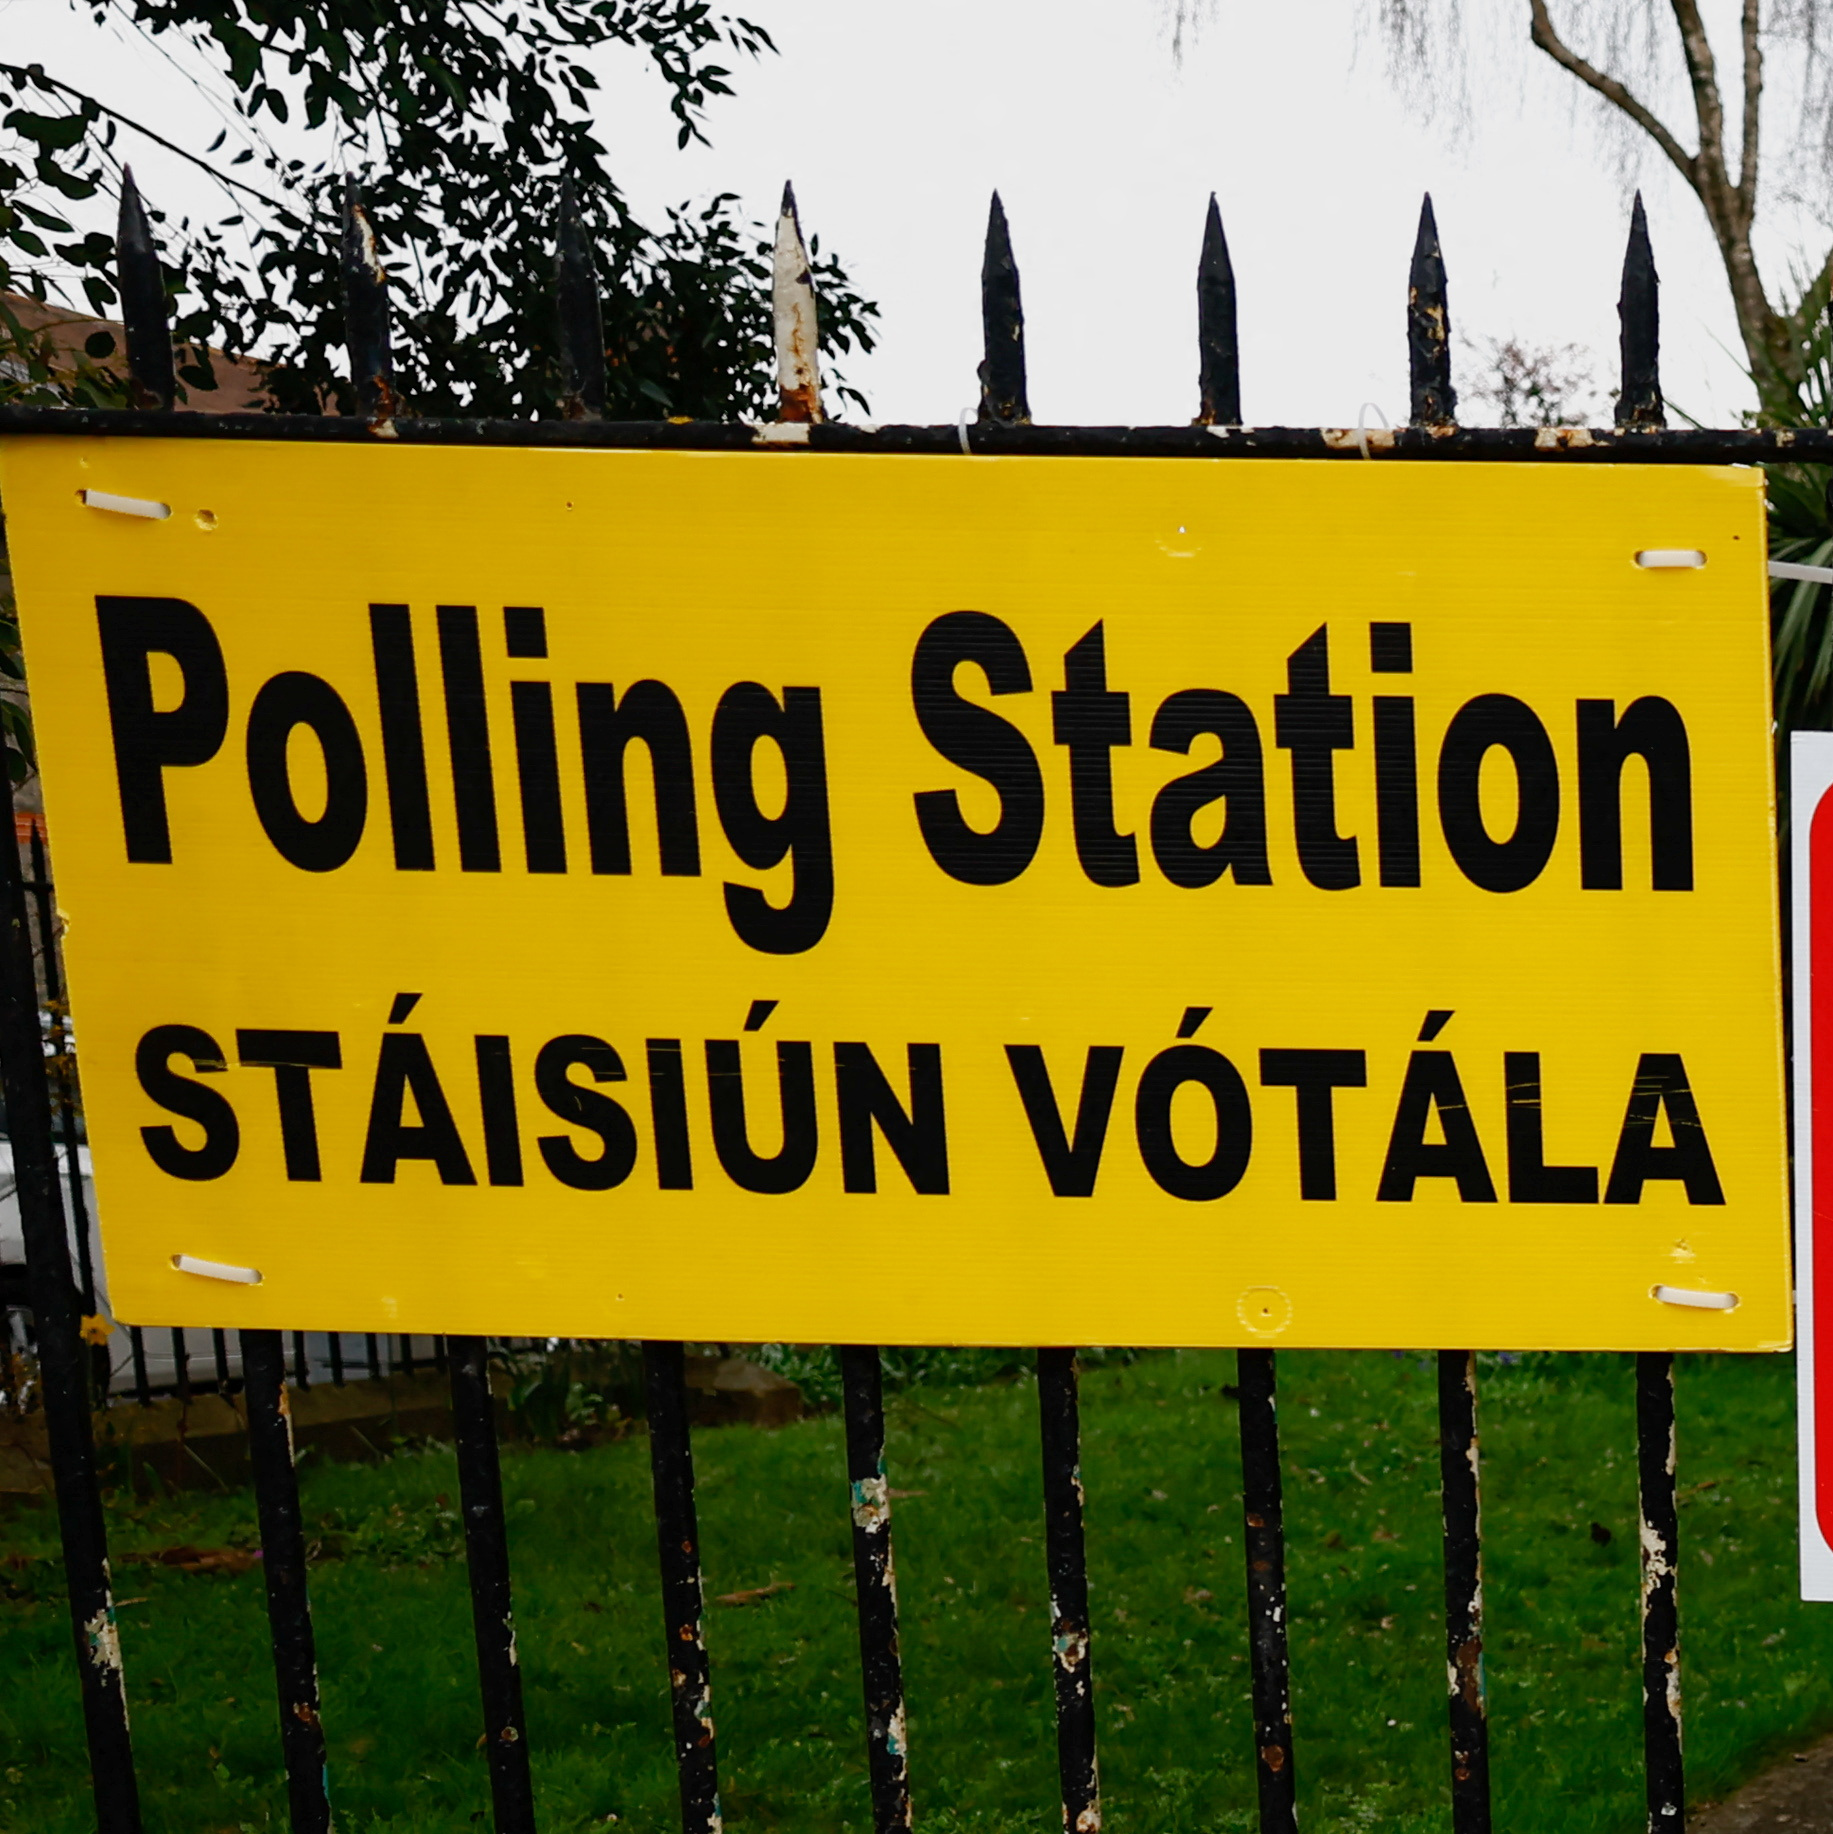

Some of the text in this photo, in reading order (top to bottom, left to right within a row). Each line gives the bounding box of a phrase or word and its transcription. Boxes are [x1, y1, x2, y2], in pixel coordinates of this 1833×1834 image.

[94, 594, 1695, 956] Polling Station
[135, 992, 1727, 1207] STÁISIÚN VÓTÁLA
